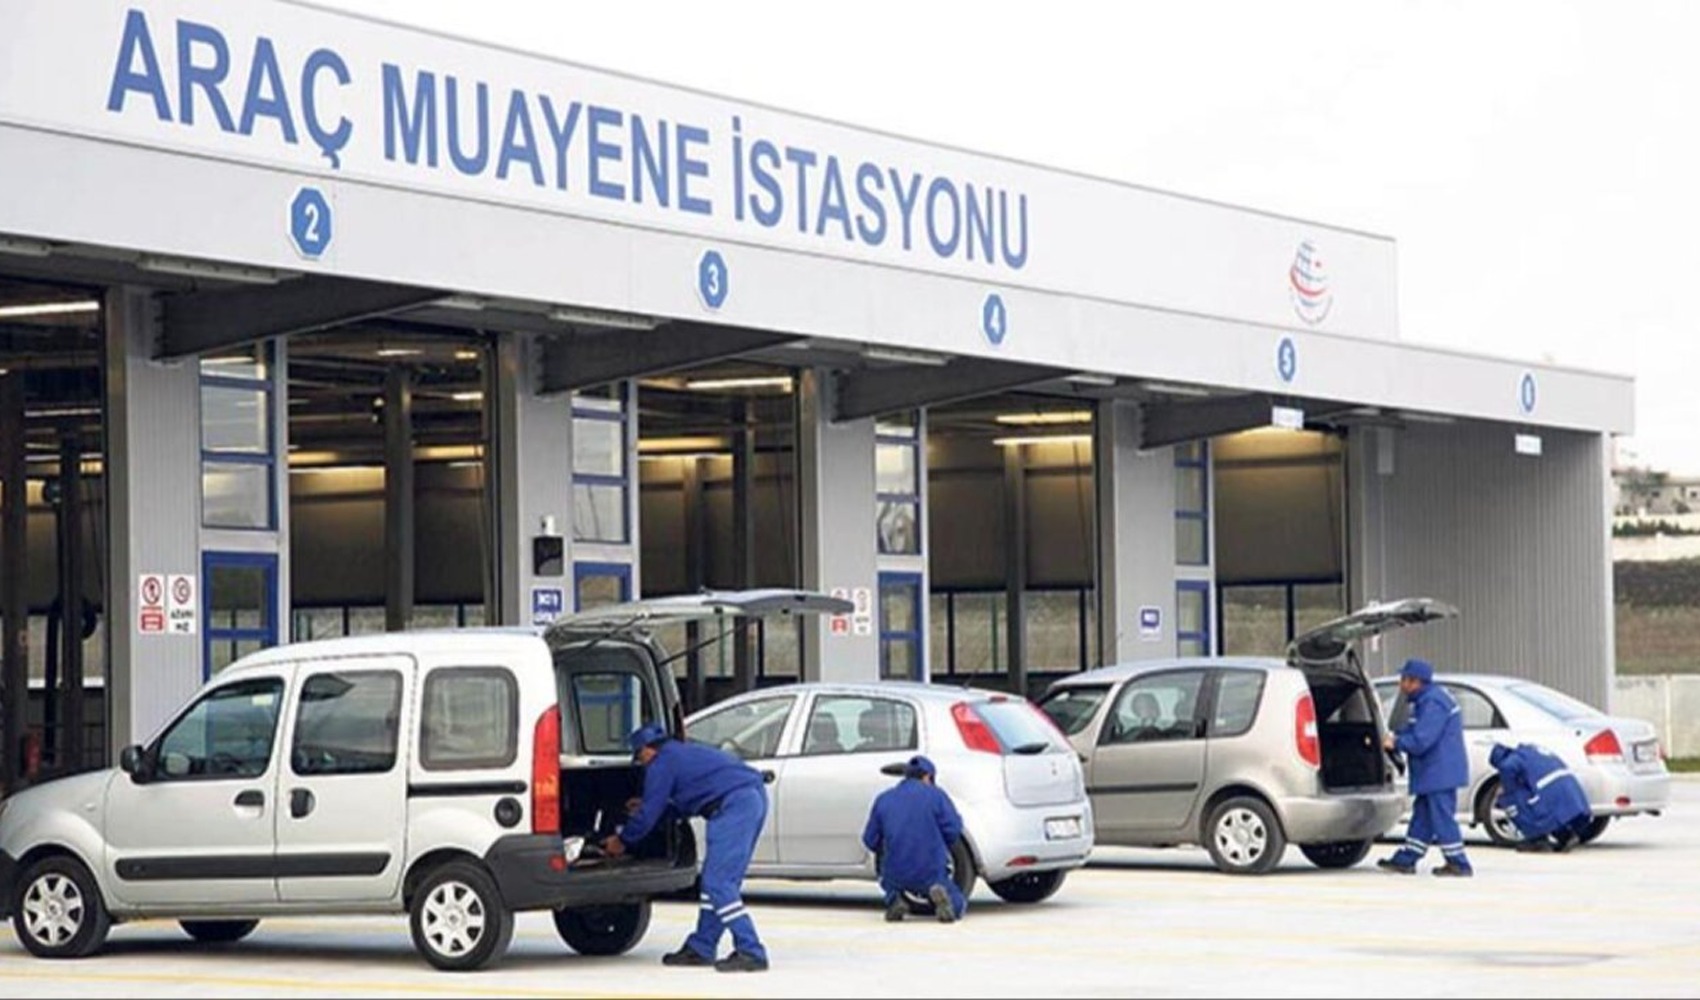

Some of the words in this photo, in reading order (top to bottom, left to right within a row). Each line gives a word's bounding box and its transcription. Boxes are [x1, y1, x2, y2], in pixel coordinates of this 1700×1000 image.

[107, 9, 354, 169] ARAÇ
[382, 63, 712, 215] MUAYENE
[732, 115, 1028, 269] İSTASYONU
[305, 203, 320, 242] 2
[708, 262, 719, 296] 3
[990, 304, 1000, 335] 4
[1283, 346, 1292, 375] 5
